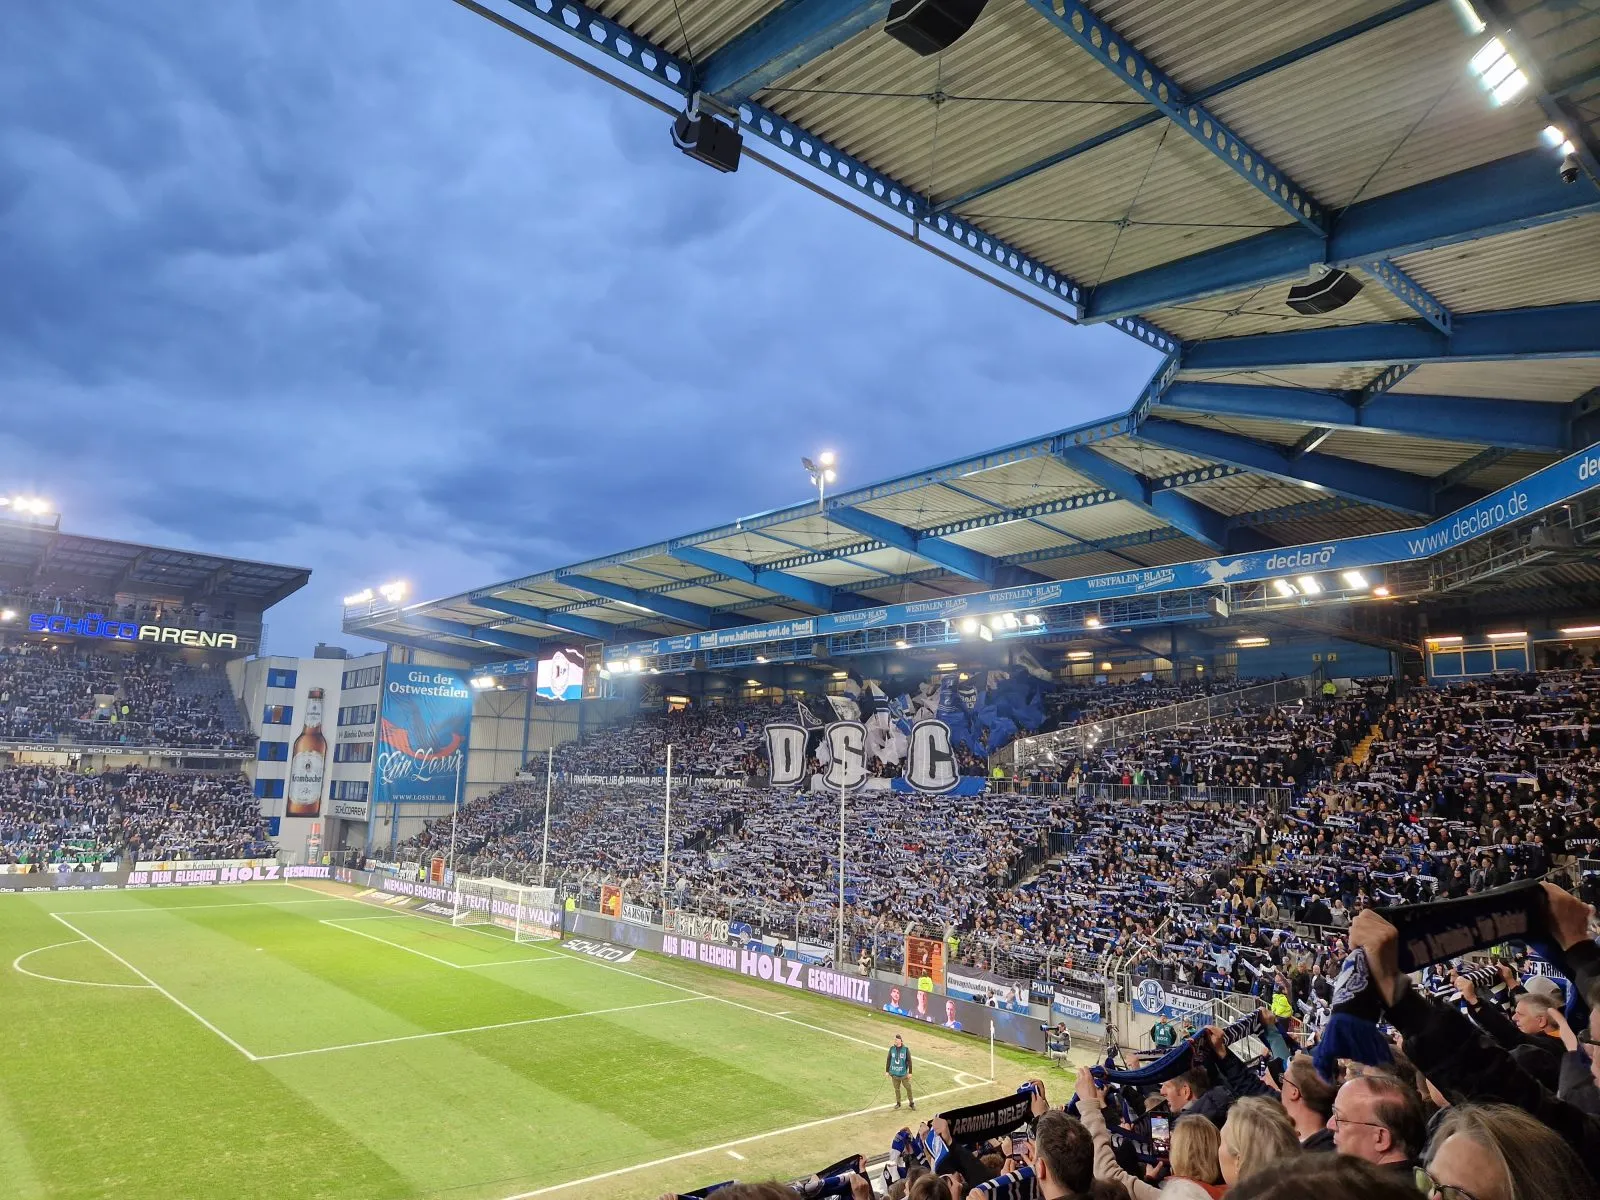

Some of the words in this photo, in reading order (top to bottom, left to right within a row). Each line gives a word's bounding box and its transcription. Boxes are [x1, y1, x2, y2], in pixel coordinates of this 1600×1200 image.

[1579, 456, 1600, 480] de
[1408, 490, 1528, 555] www.declaro.de
[1266, 547, 1332, 570] declaro
[1087, 568, 1173, 589] WESTFALEN-BLATT
[989, 584, 1060, 602] WESTFALEN-BLATT
[905, 598, 968, 613] WESTFALEN-BLATT
[719, 624, 790, 643] www.hallenbau-owl.de
[408, 671, 430, 684] Gin
[433, 673, 454, 685] der
[389, 682, 468, 698] Ostwestfalen
[292, 773, 322, 784] Krombacher
[128, 871, 148, 884] AUS
[151, 870, 171, 883] DEM
[175, 869, 217, 883] GLEICHEN
[221, 866, 280, 882] HOLZ
[384, 878, 413, 895] NIEMAND
[415, 884, 446, 902] EROBERT
[622, 904, 651, 924] SAMSON
[562, 939, 624, 960] SCHÜCO
[663, 935, 678, 955] AUS
[680, 939, 697, 959] DEM
[700, 943, 737, 969] GLEICHEN
[741, 950, 803, 988] HOLZ
[807, 968, 873, 1003] GESCHNITZT.
[1171, 983, 1207, 999] Arminia
[1062, 996, 1075, 1007] The
[1077, 1000, 1093, 1011] Firm
[953, 1111, 995, 1135] ARMINIA
